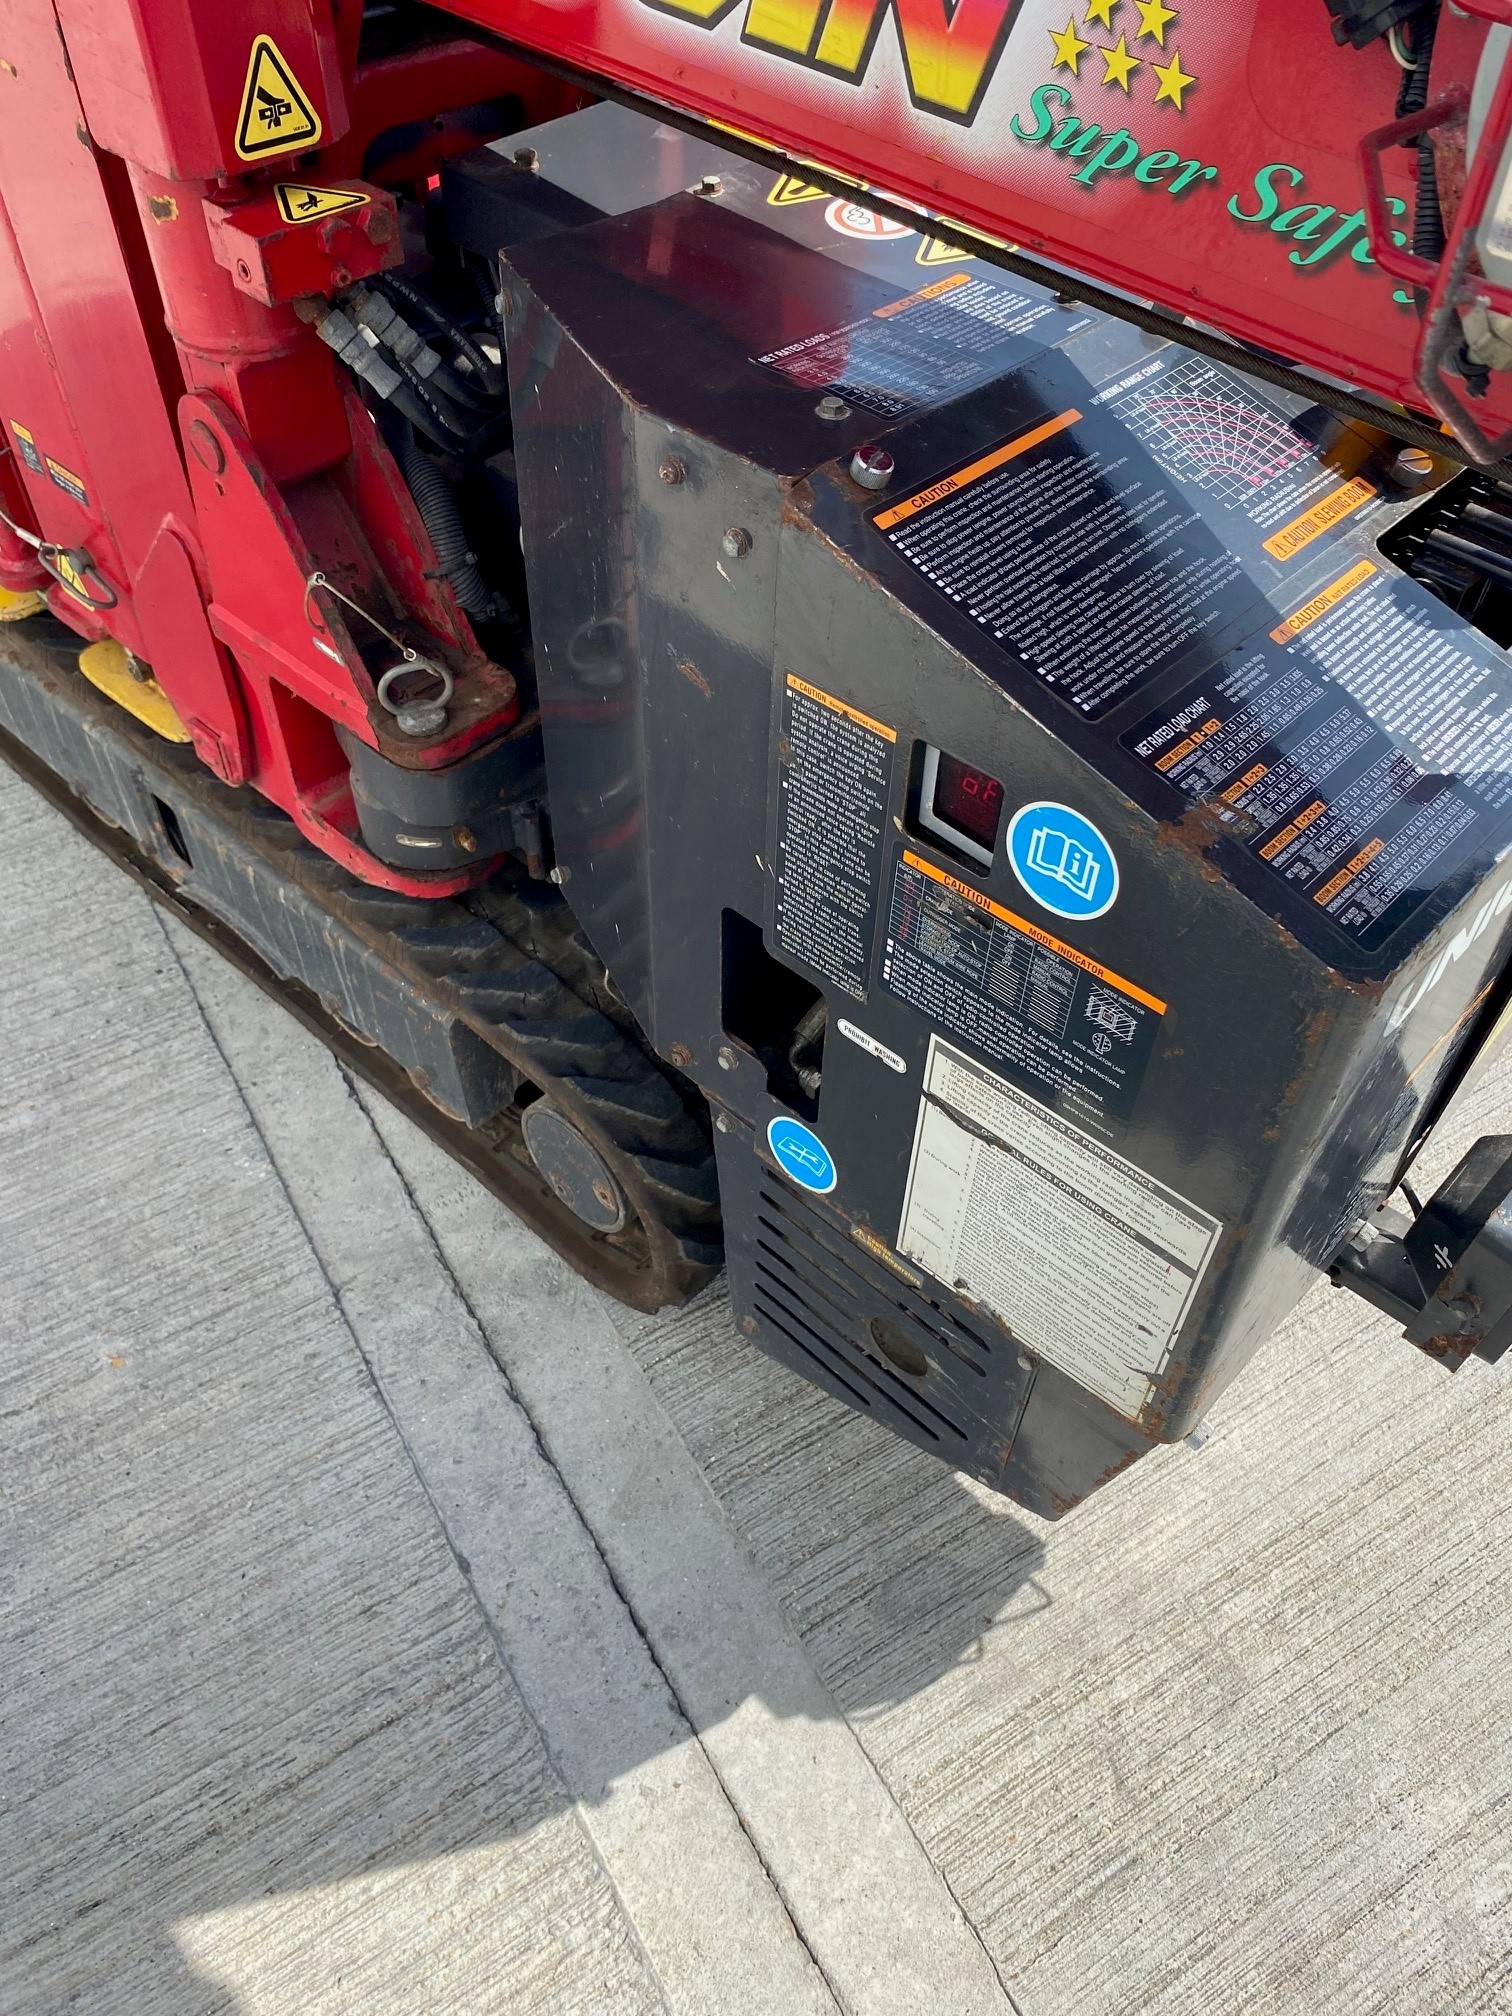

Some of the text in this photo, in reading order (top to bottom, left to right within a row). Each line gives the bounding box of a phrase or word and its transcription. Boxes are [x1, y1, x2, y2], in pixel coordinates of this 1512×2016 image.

[1010, 84, 1218, 194] Super
[897, 280, 958, 308] CAUTIONS
[757, 333, 831, 363] NET RATED LOADS
[1088, 360, 1165, 406] WORKING RANGE CHART
[1188, 369, 1216, 386] Boom angle
[894, 526, 912, 538] Read
[908, 521, 921, 530] the
[917, 506, 946, 525] instruction
[943, 496, 965, 510] manual
[961, 485, 985, 500] carefully
[981, 476, 1000, 489] before
[902, 533, 921, 546] When
[917, 519, 945, 537] operating
[941, 514, 954, 523] this
[966, 496, 984, 509] check
[981, 491, 993, 500] the
[989, 476, 1020, 495] surrounding
[1016, 469, 1031, 479] area
[1028, 465, 1038, 473] for
[909, 478, 958, 508] CAUTION
[1245, 498, 1272, 517] WORKING
[1281, 517, 1321, 547] CAUTION
[1312, 495, 1352, 524] SLEWING
[1342, 481, 1371, 503] BOOM
[950, 577, 969, 591] Place
[965, 572, 977, 582] the
[973, 563, 992, 576] crane
[988, 556, 1004, 567] level
[1000, 547, 1018, 560] using
[1286, 594, 1333, 631] CAUTION
[799, 682, 826, 703] CAUTION
[820, 708, 829, 718] two
[831, 713, 850, 730] seconds
[852, 725, 863, 737] after
[865, 732, 873, 743] the
[874, 738, 883, 748] key
[1133, 696, 1212, 757] NET RATED LOAD CHART
[1201, 679, 1291, 751] 1.0 1.4 1.5 1.8 2.0 2.5 3.0 3.5
[1203, 720, 1219, 732] 1+2
[1212, 749, 1224, 760] 2.9
[1224, 740, 1236, 750] 2.9
[1234, 730, 1248, 742] 2.65
[1244, 721, 1259, 733] 2.25
[1256, 712, 1271, 724] 2.05
[1280, 696, 1291, 705] 1.3
[1290, 687, 1301, 696] 1.0
[1300, 678, 1312, 688] 0.9
[791, 710, 878, 764] Do not operate the crane during this
[1157, 741, 1192, 768] BOOM SECTION
[1223, 783, 1243, 800] ECTION
[1244, 765, 1265, 782] 1+2+3
[1296, 802, 1323, 826] 1+2+3+4
[1261, 826, 1296, 857] BOOM SECTION
[1349, 839, 1382, 870] 1+2+3+4+5
[1359, 843, 1398, 882] 3.8 4.1 4.5 5.0
[944, 874, 990, 910] CAUTION
[1315, 870, 1350, 903] BOOM SECTION
[1325, 895, 1345, 913] WORKING
[1028, 927, 1104, 977] MODE INDICATOR
[894, 942, 904, 953] The
[905, 949, 921, 964] above
[922, 960, 935, 973] table
[937, 969, 954, 984] shows
[954, 980, 963, 990] the
[964, 987, 977, 999] main
[978, 996, 994, 1010] mode
[1027, 1027, 1038, 1037] For
[1061, 1048, 1072, 1059] see
[1073, 1055, 1083, 1066] the
[1102, 987, 1145, 1016] MODE INDICATOR
[844, 1025, 900, 1068] PROHIBIT WASHING
[1072, 1040, 1125, 1075] MODE INDICATOR LAMP
[948, 1077, 966, 1094] Lifting
[967, 1090, 991, 1111] capacity
[992, 1107, 1000, 1116] of
[1000, 1112, 1010, 1123] the
[1011, 1119, 1028, 1135] crane
[1029, 1131, 1053, 1152] reduces
[1063, 1154, 1074, 1166] the
[1075, 1162, 1101, 1183] working
[1102, 1180, 1123, 1197] radius
[1123, 1194, 1155, 1219] increases
[983, 1073, 1065, 1132] CHARACTERISTICS
[1067, 1129, 1079, 1141] OF
[1082, 1139, 1155, 1191] PERFORMANCE
[1022, 1156, 1137, 1238] RULES FOR USING CRANE
[882, 1252, 921, 1286] temperature
